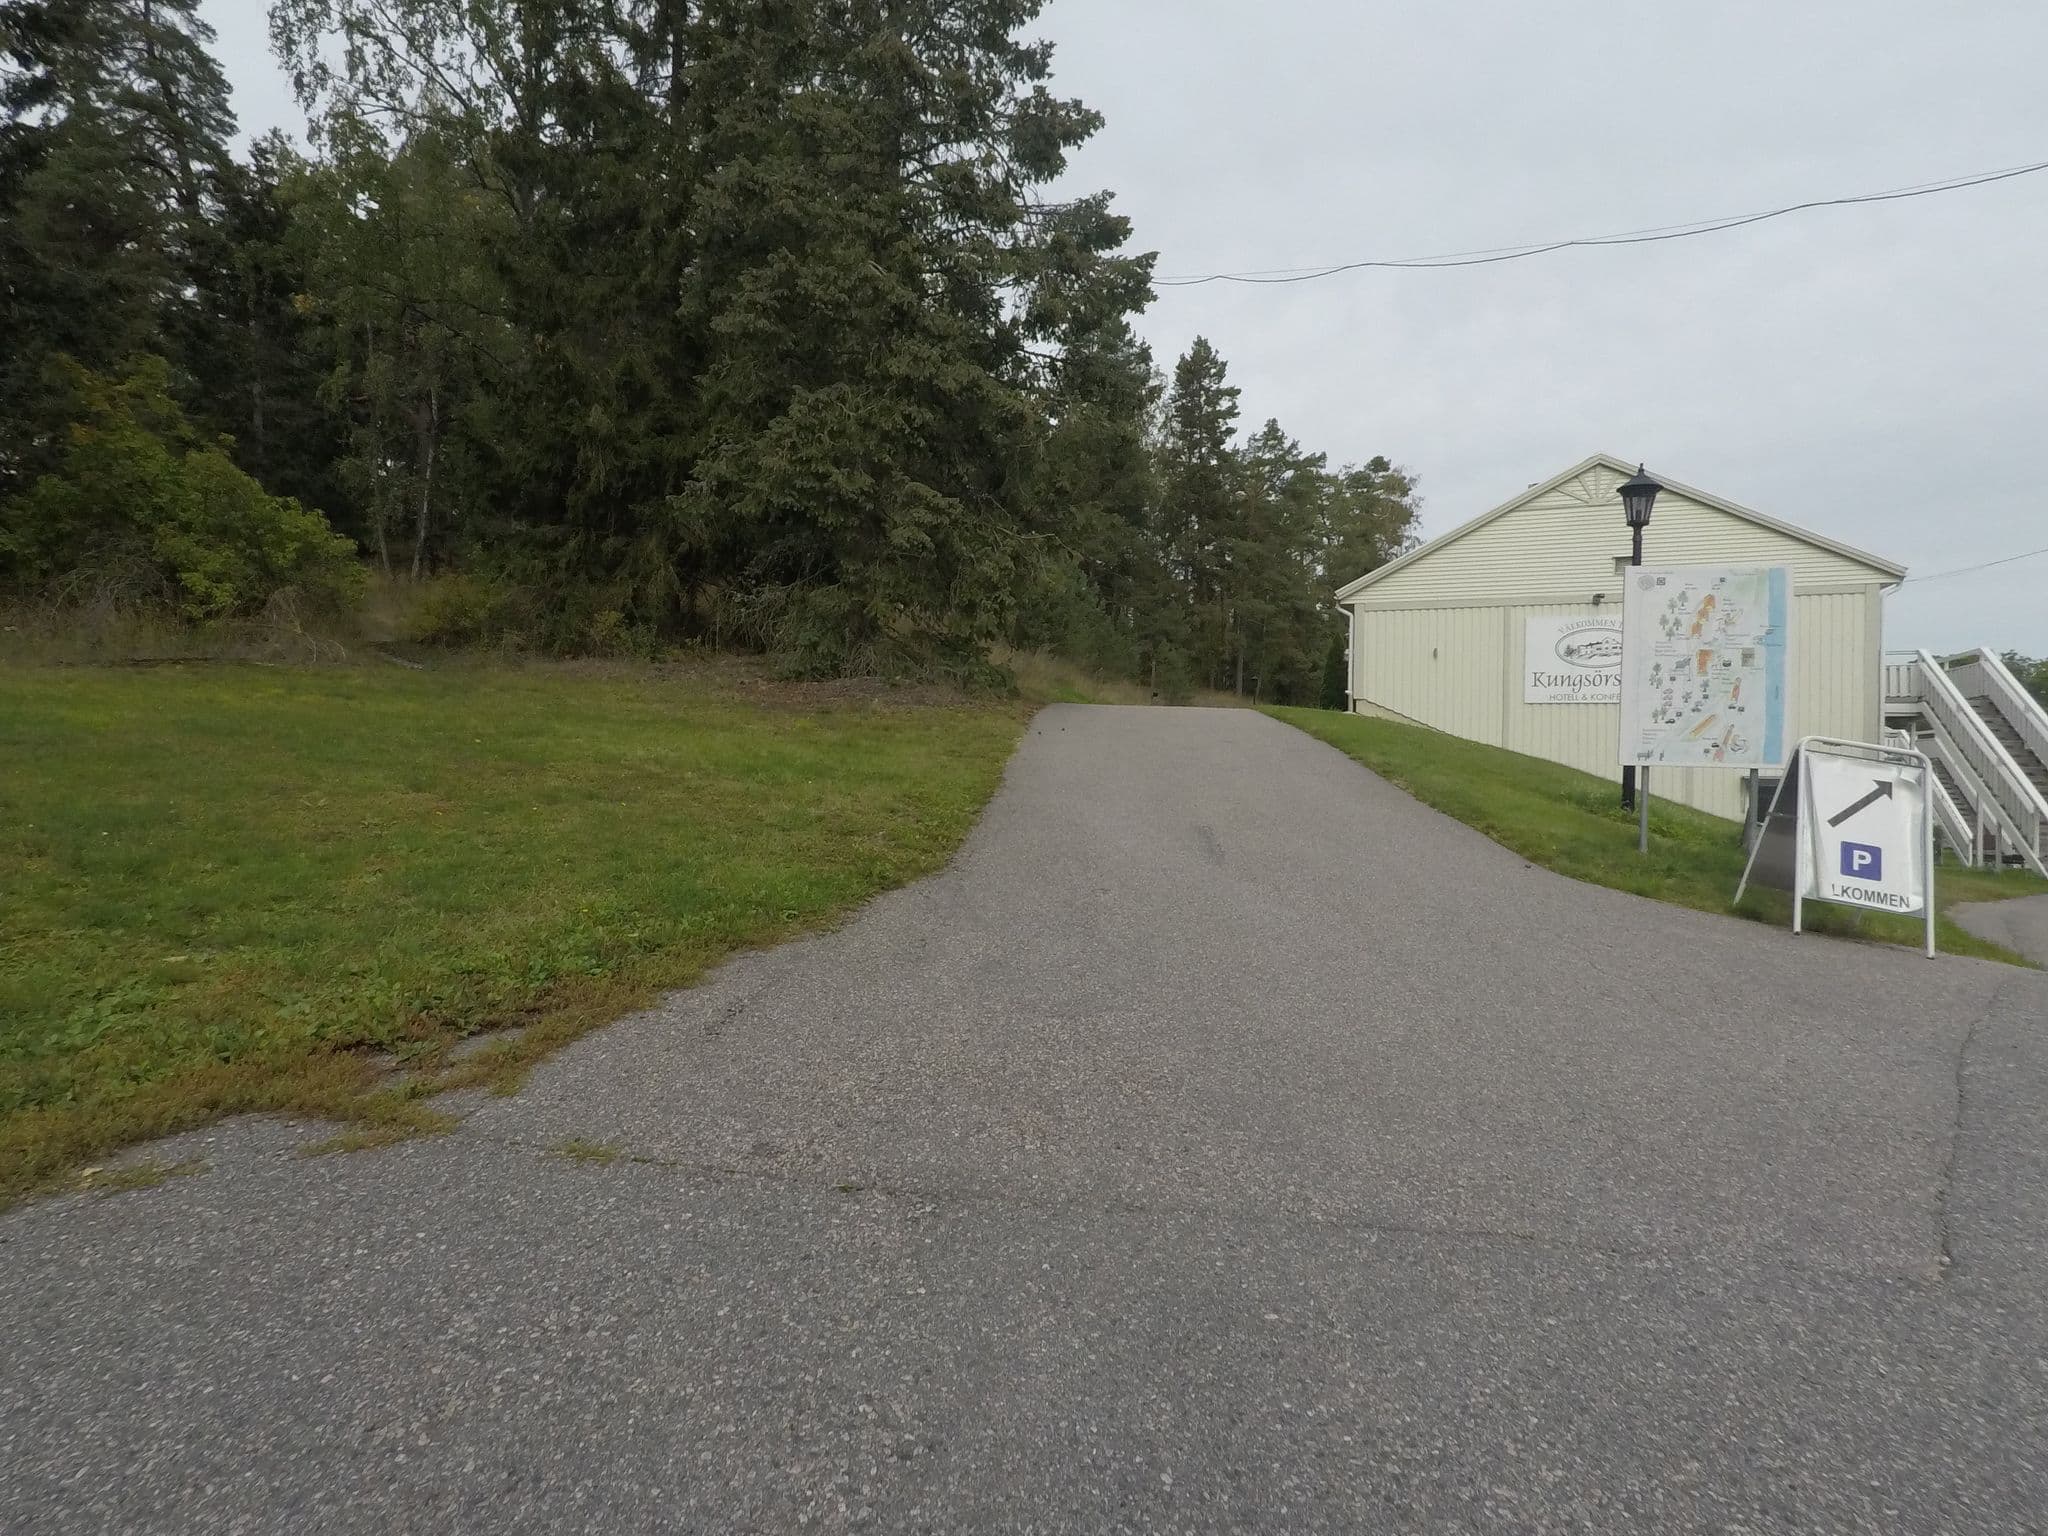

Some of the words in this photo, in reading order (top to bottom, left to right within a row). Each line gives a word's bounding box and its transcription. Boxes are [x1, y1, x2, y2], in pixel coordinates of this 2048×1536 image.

[1558, 618, 1617, 634] VÄLKOMMEN
[1549, 693, 1579, 702] HOTELL
[1582, 693, 1588, 701] &
[1852, 849, 1872, 871] P
